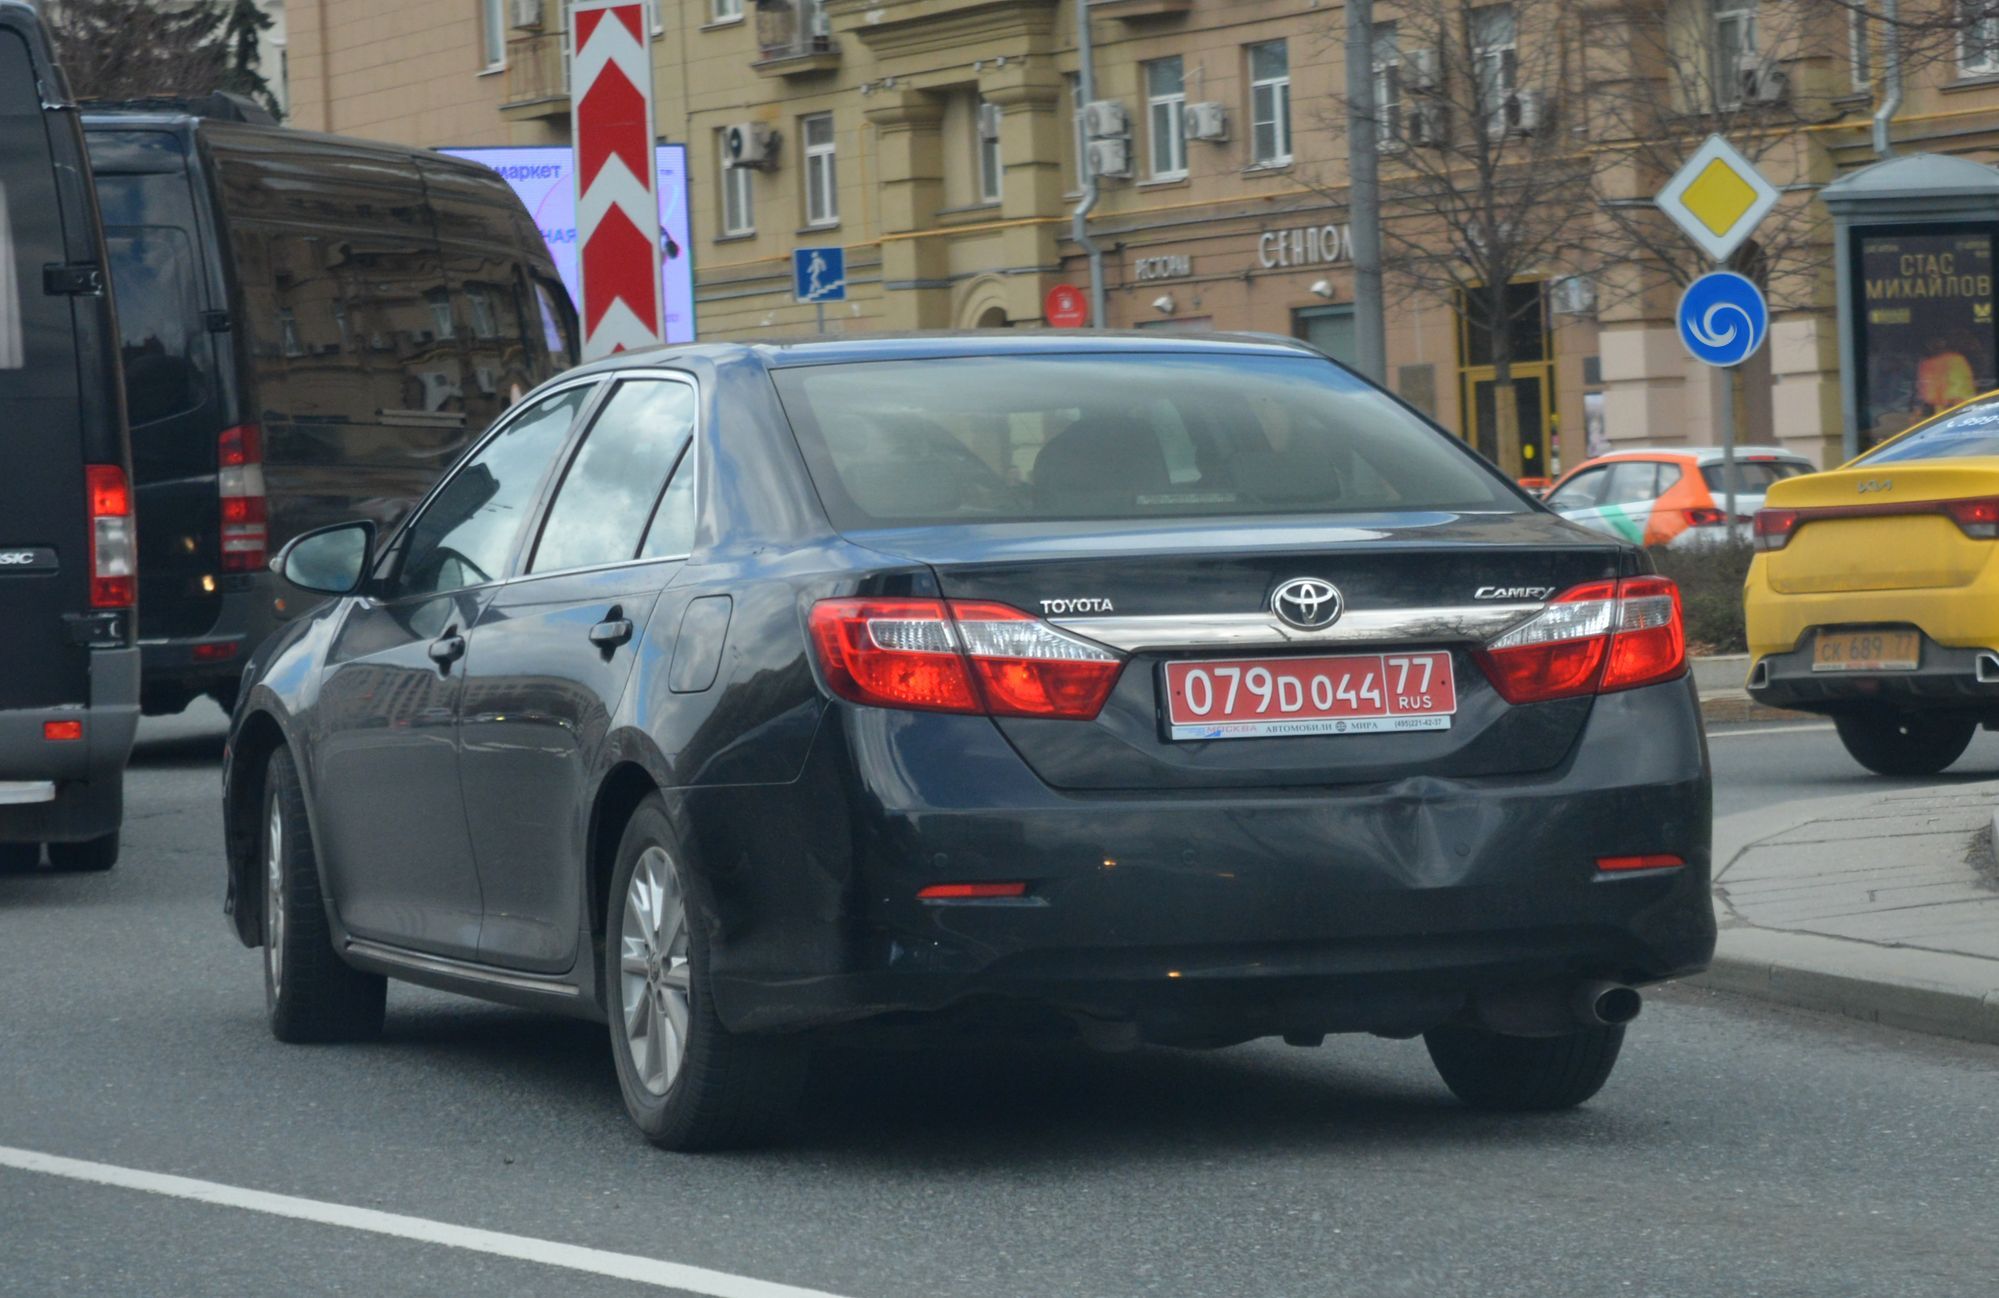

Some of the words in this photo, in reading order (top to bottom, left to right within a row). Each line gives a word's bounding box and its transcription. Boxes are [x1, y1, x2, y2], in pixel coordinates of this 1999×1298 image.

[1900, 253, 1954, 276] СТАС
[1865, 274, 1991, 299] МИХАЙЛОВ
[1474, 586, 1556, 600] CAMRY
[1040, 598, 1114, 614] TOYOTA
[1388, 657, 1434, 695] 77
[1398, 696, 1433, 710] RUS
[1265, 721, 1333, 734] АВТОМОБИЛИ
[1351, 721, 1379, 731] МИРА
